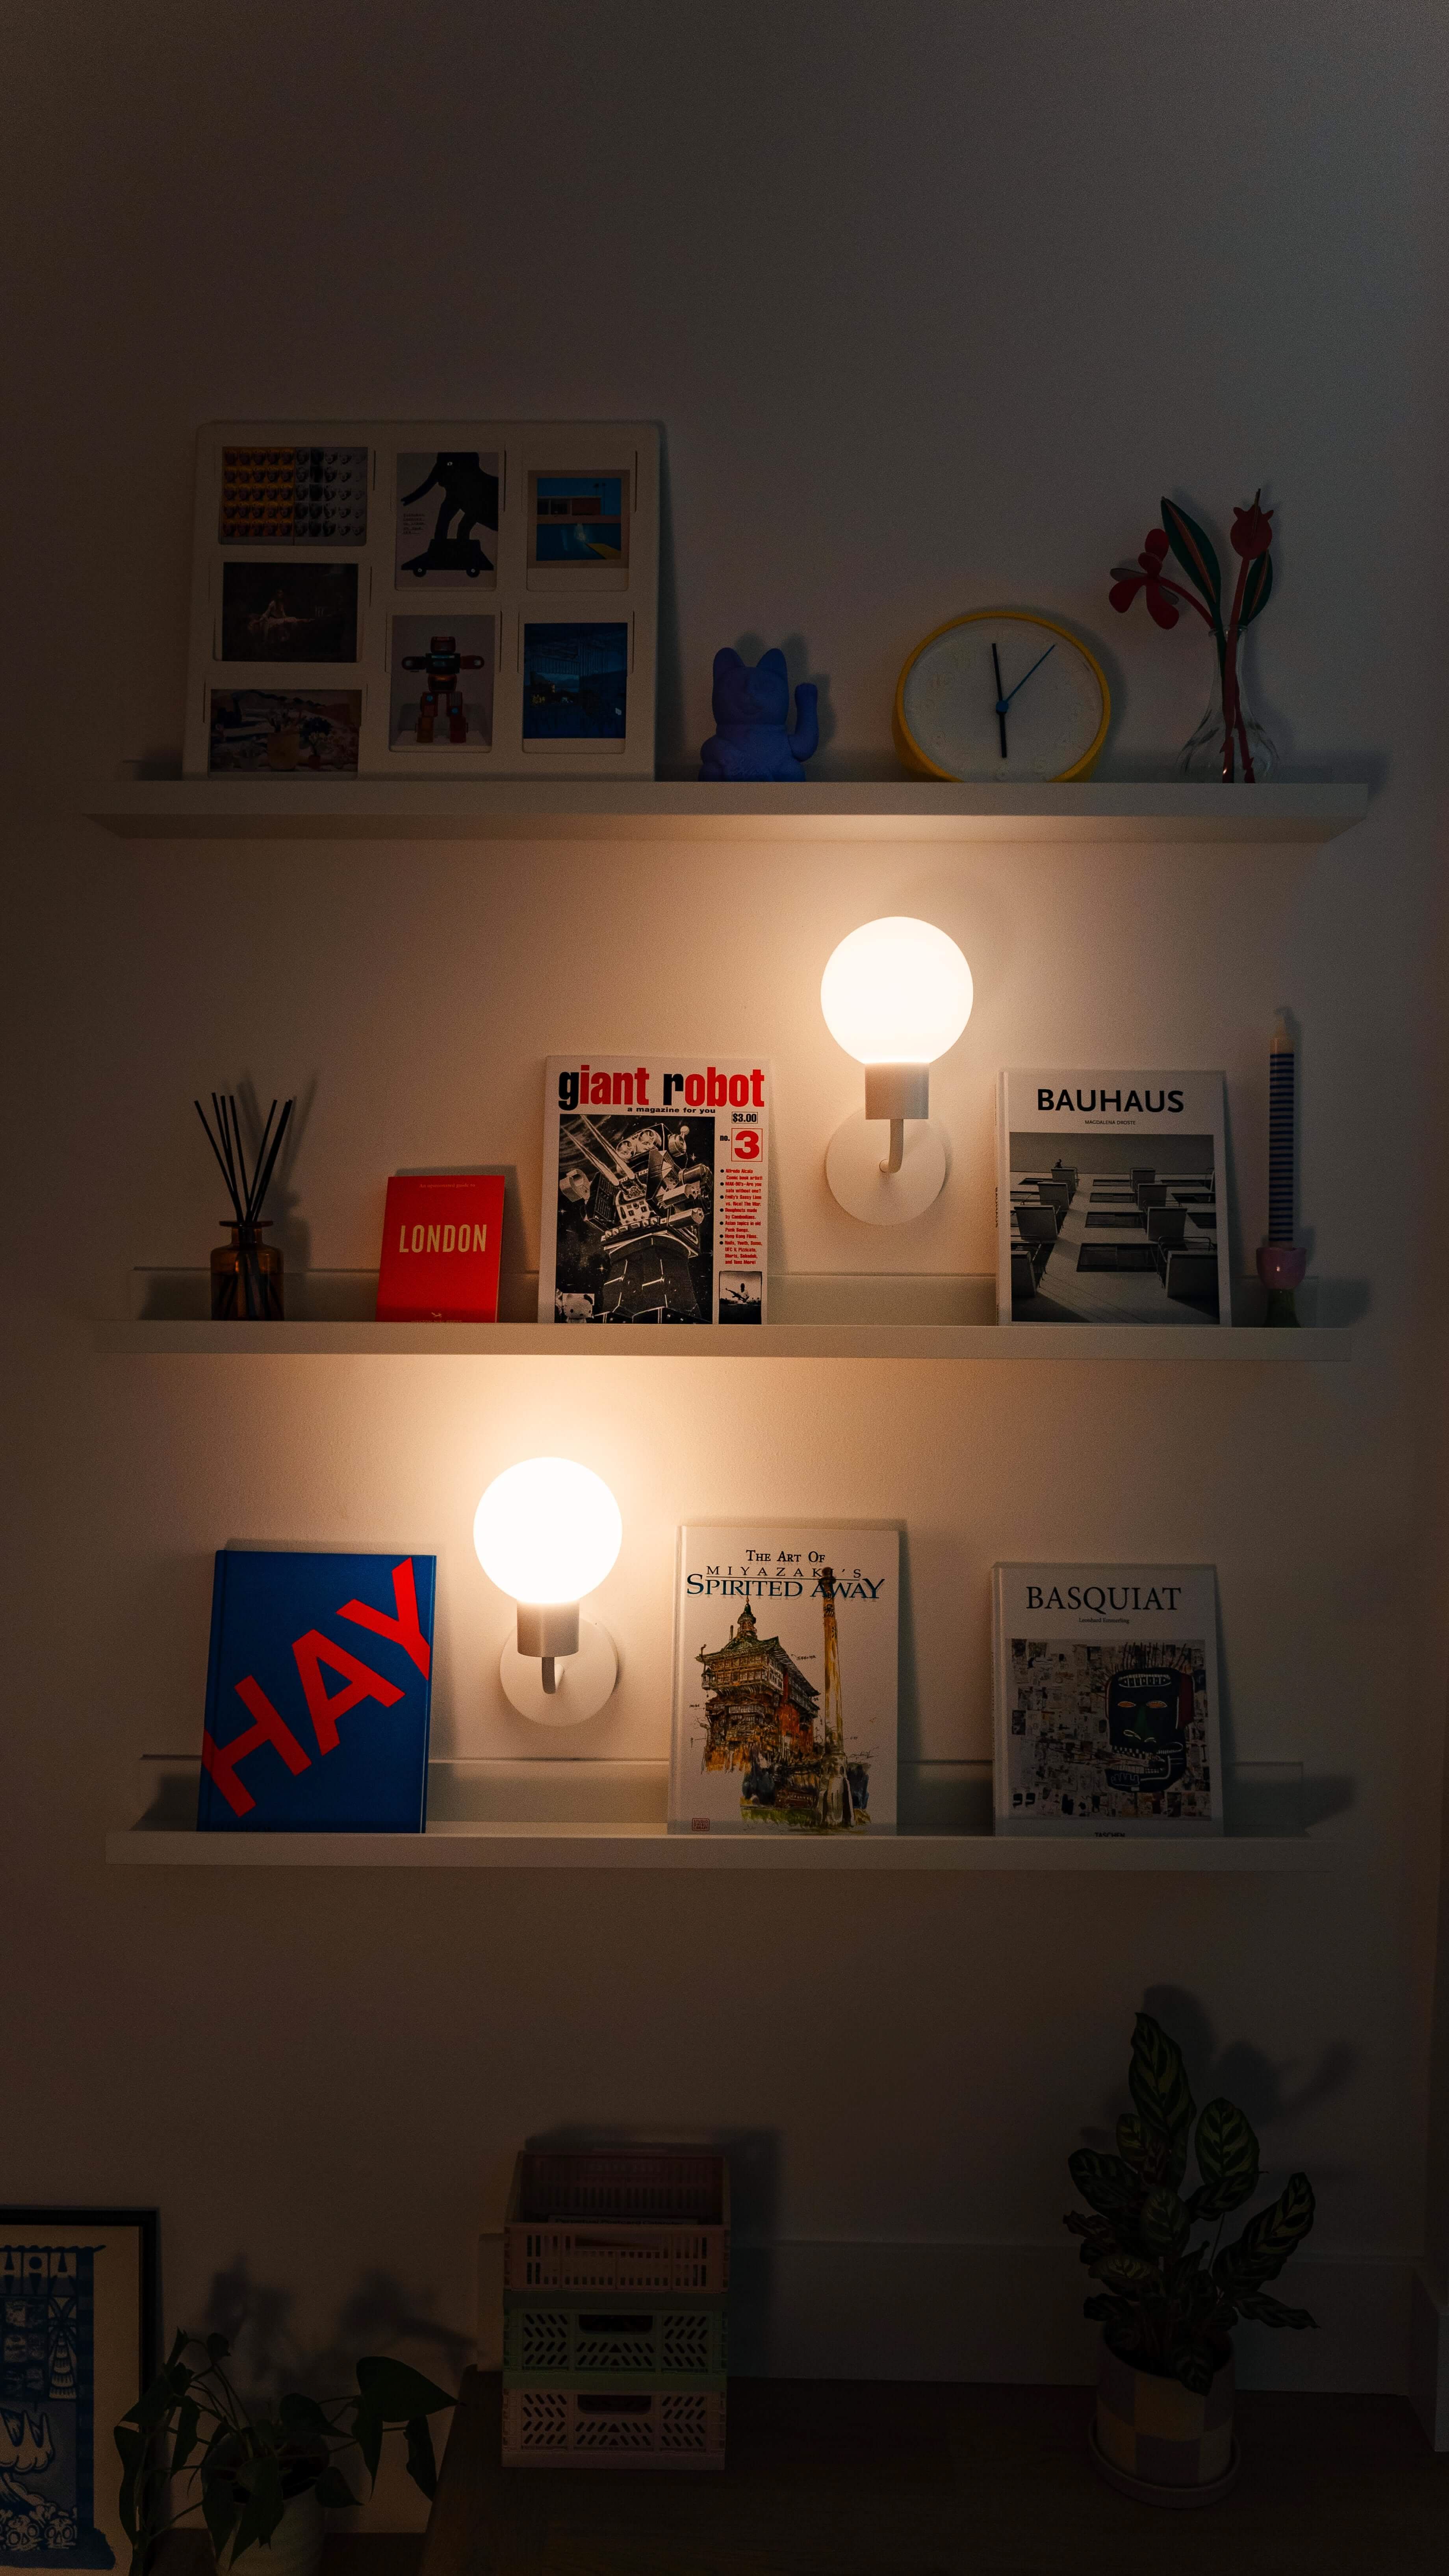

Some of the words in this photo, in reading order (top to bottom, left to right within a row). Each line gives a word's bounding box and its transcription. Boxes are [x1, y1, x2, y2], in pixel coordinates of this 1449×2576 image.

[558, 1065, 649, 1111] giant
[663, 1067, 764, 1107] robot
[1037, 1089, 1184, 1113] BAUHAUS
[733, 1113, 757, 1123] $3.00
[734, 1130, 760, 1159] 3
[399, 1224, 487, 1253] LONDON
[706, 1565, 861, 1578] MIYAZAKI'S
[687, 1574, 803, 1597] SPIRITED
[810, 1578, 885, 1599] AWAY
[1026, 1586, 1181, 1615] BASQUIAT
[202, 1556, 430, 1818] HAY
